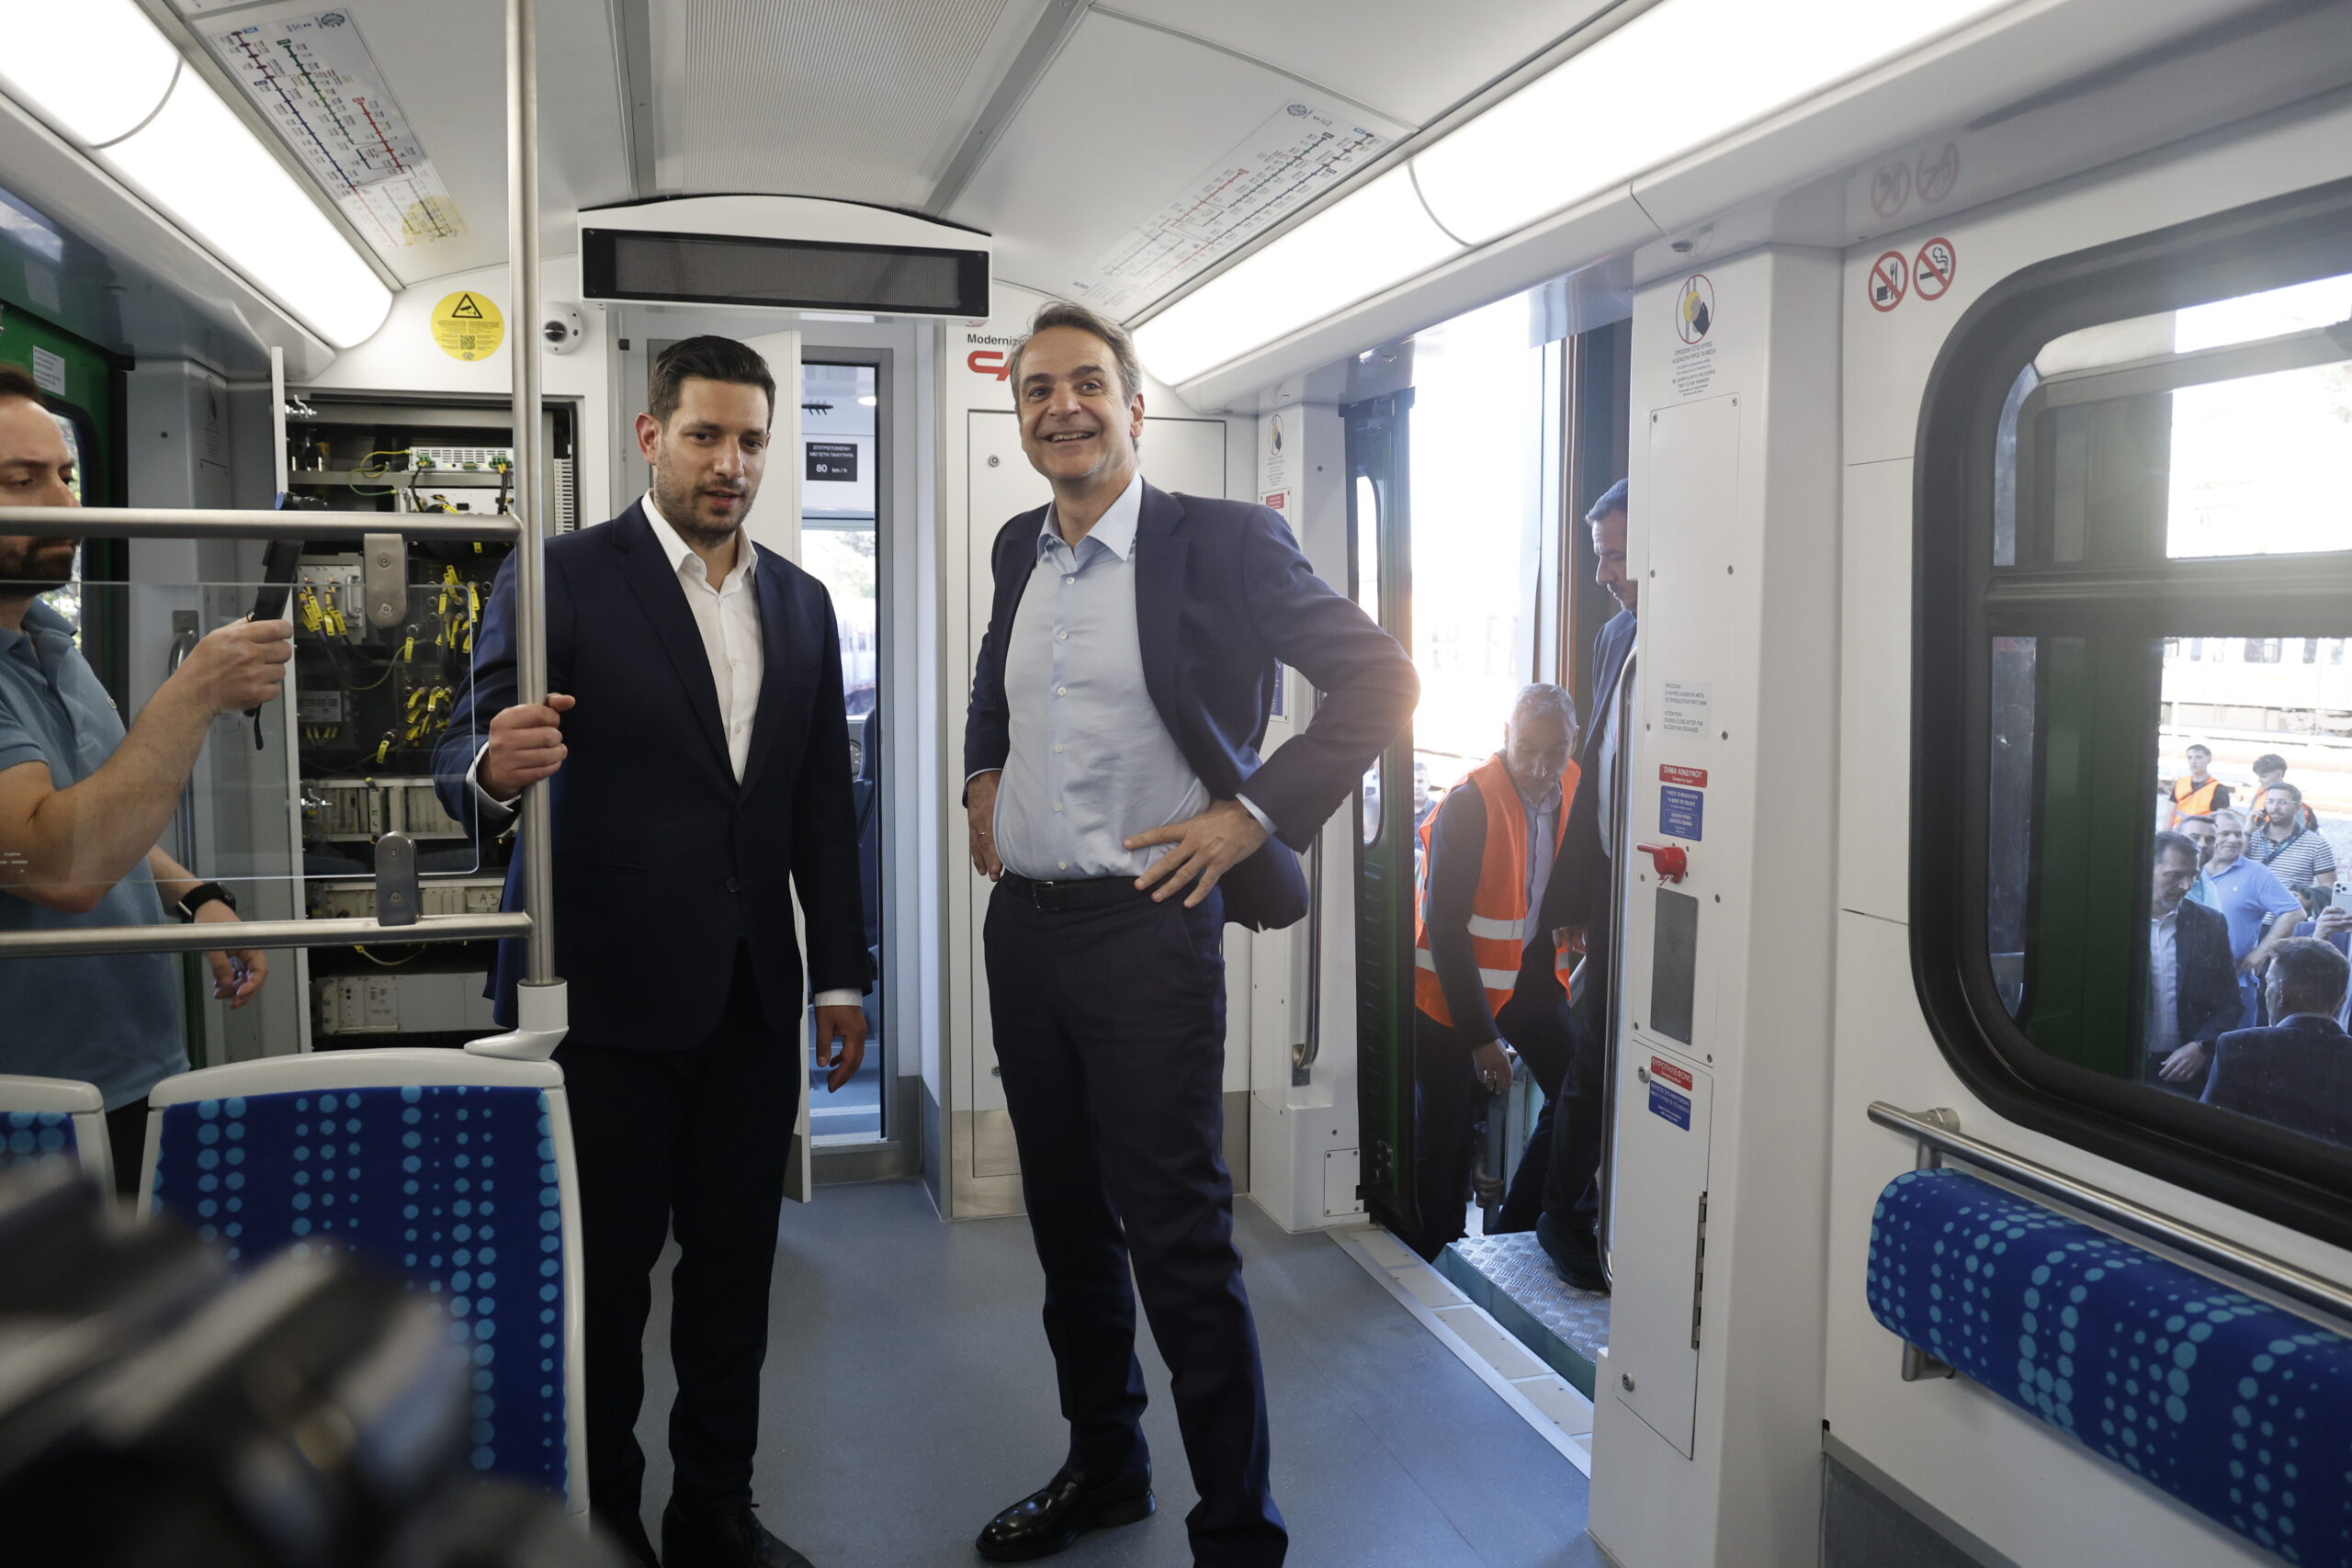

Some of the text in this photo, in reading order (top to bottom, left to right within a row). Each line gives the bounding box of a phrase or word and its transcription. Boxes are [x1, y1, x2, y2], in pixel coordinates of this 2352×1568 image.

[816, 463, 828, 473] 80
[1664, 766, 1702, 778] ΣΗΜΑ ΚΙΝΔΥΝΟΥ
[1651, 1058, 1692, 1082] ΘΥΡΟΤΗΛΕΦΩΝΟ
